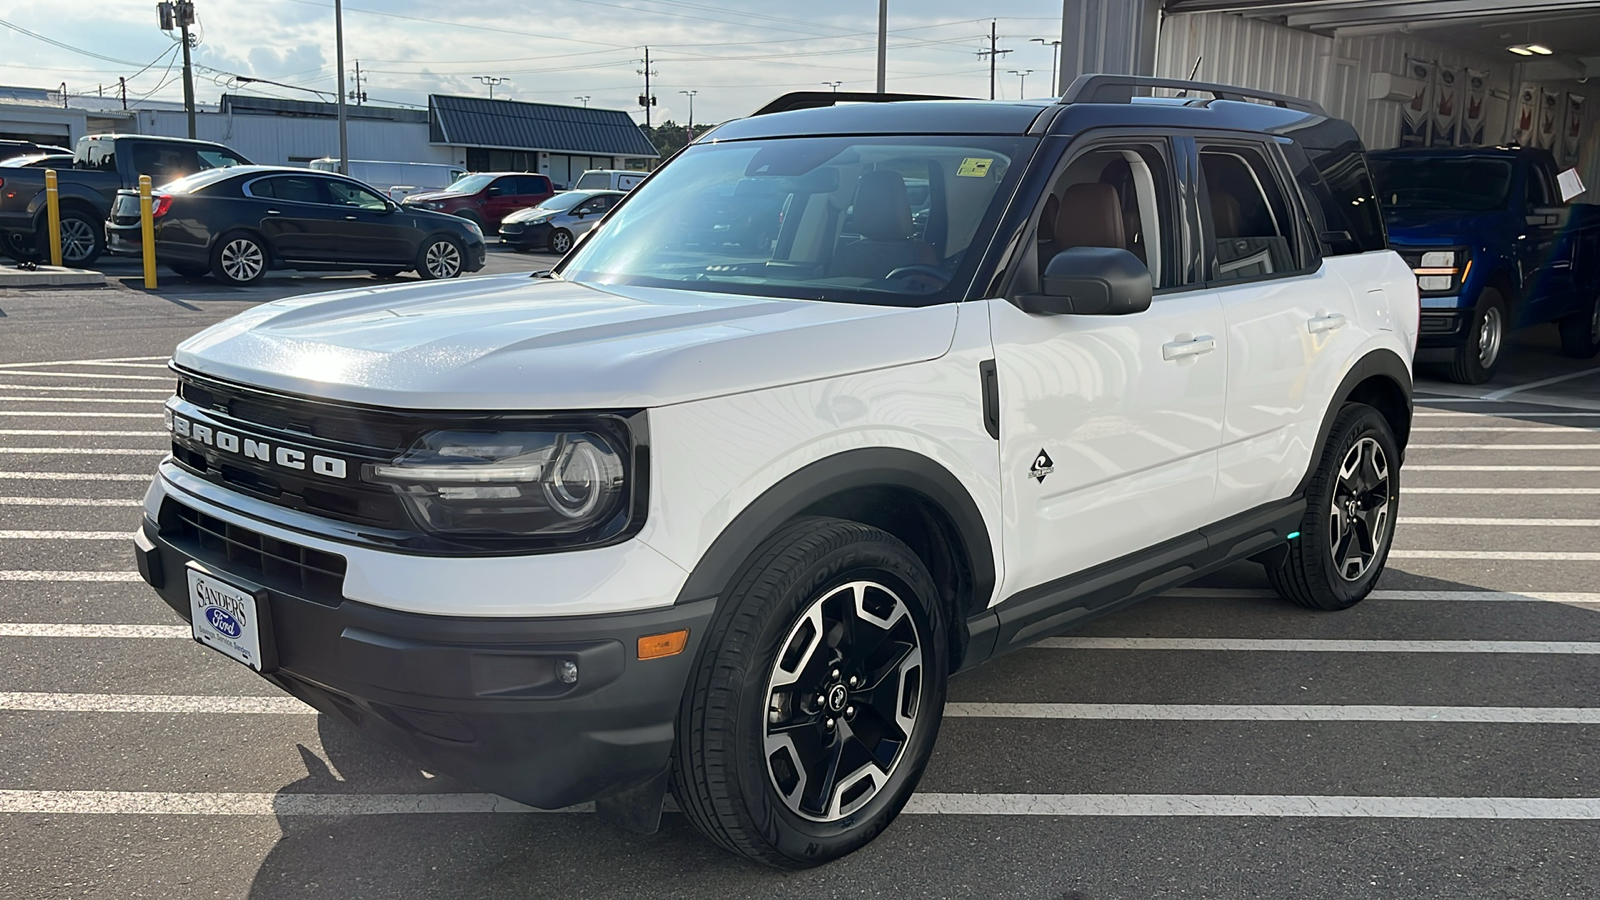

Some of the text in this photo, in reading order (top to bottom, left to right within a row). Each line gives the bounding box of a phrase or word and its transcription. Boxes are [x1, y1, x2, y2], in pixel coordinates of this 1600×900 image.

[173, 415, 347, 479] BRONCO
[196, 582, 246, 627] SANDERS
[212, 609, 235, 635] Ford
